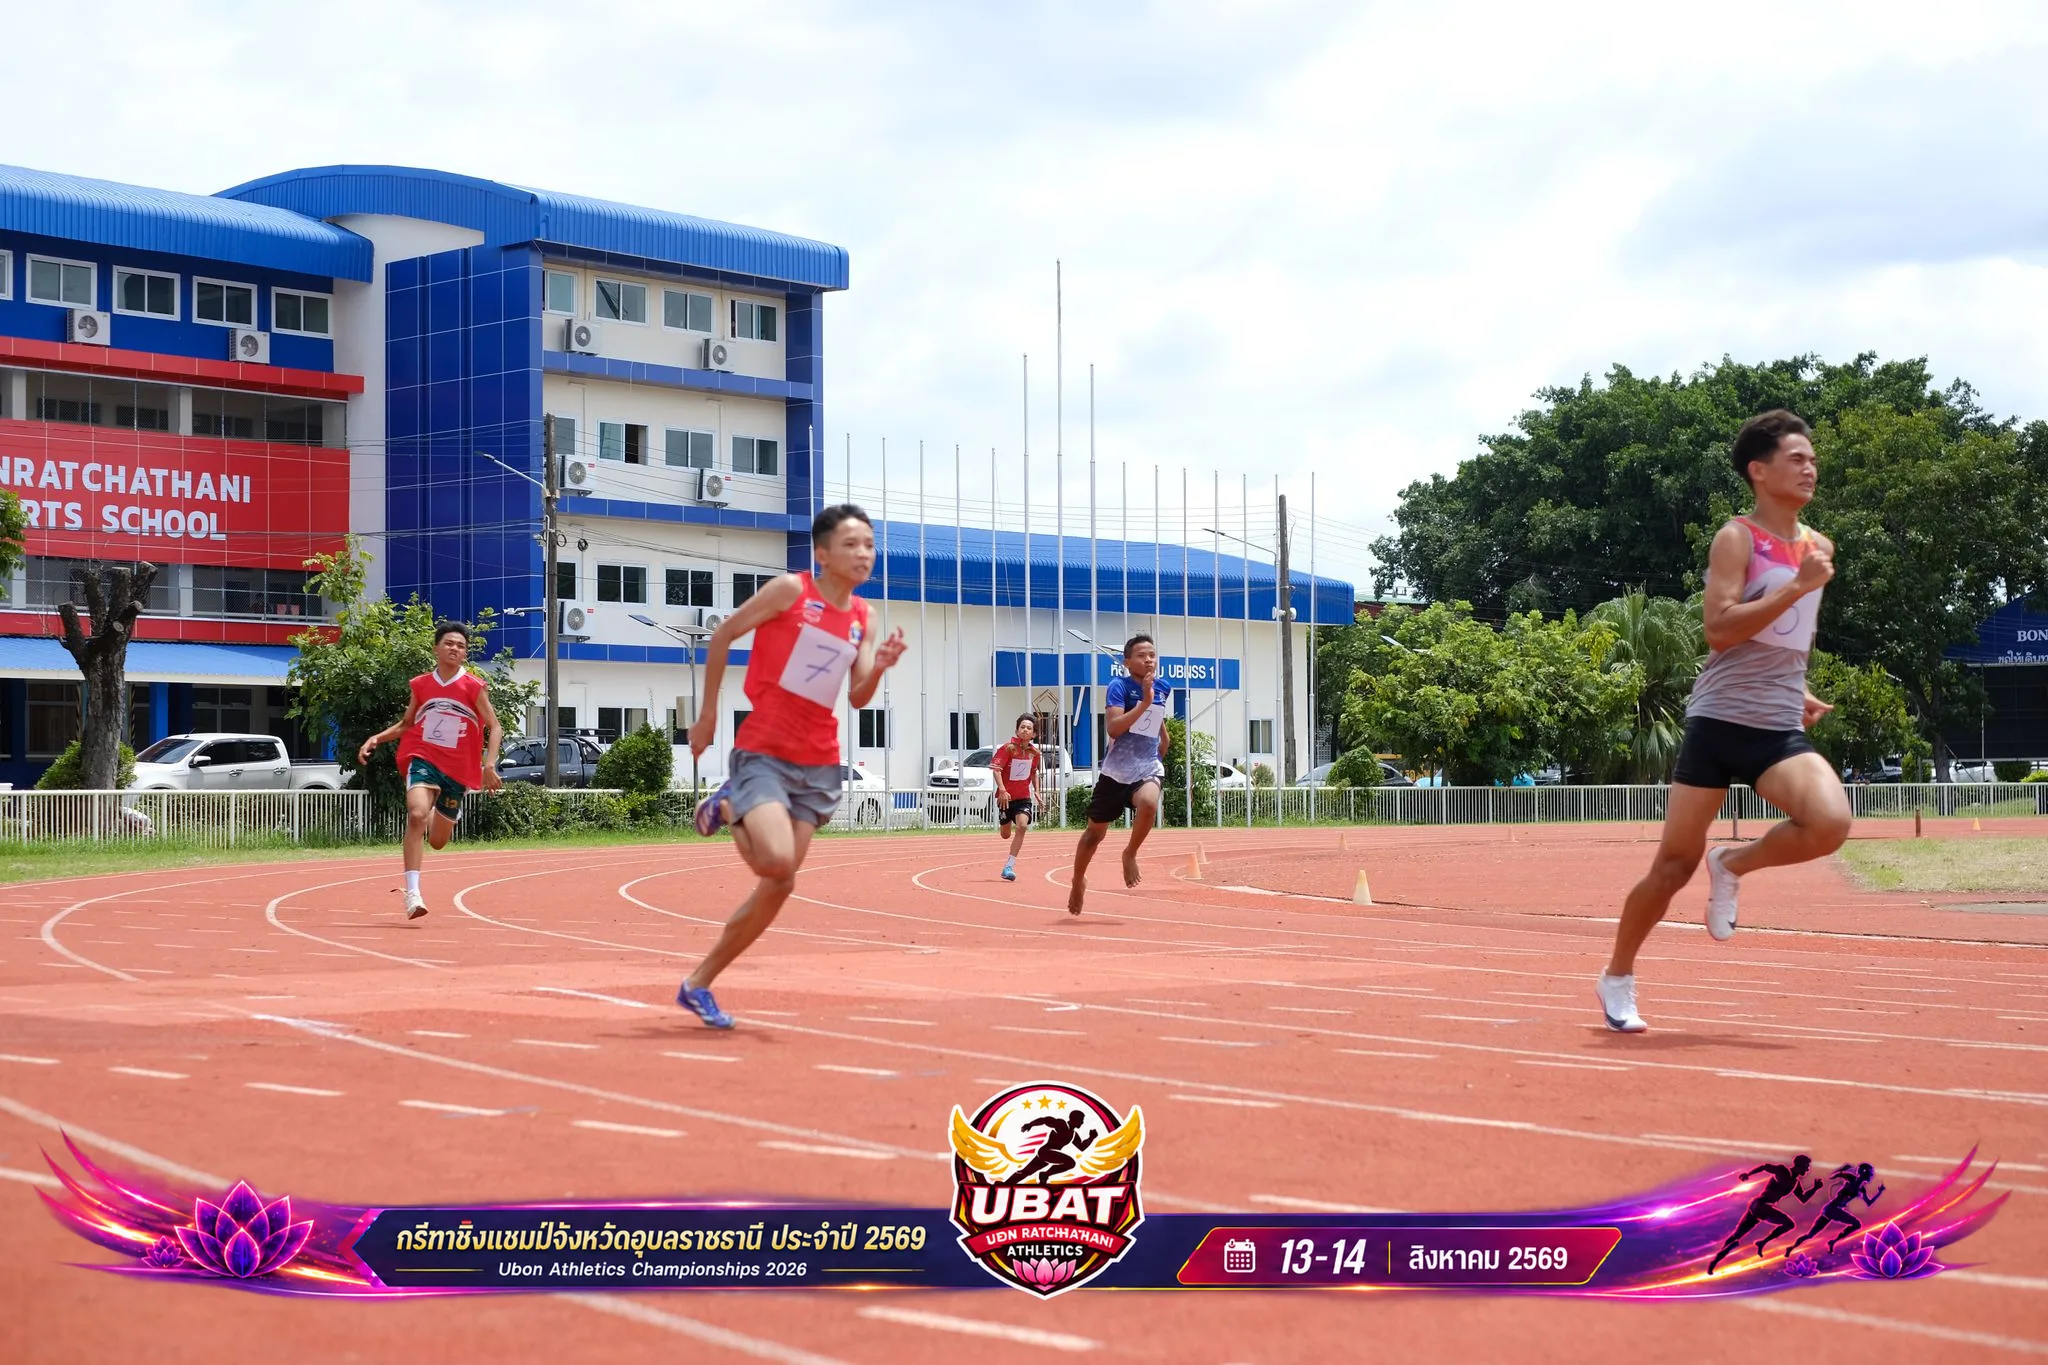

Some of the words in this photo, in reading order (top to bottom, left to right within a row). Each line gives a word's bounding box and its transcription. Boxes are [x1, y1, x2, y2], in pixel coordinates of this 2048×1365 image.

[20, 499, 83, 531] RTS
[102, 503, 227, 541] SCHOOL
[2017, 629, 2048, 642] BON
[805, 643, 841, 683] 7
[1209, 665, 1215, 680] 1
[431, 718, 443, 739] 6
[1138, 709, 1153, 732] 3
[1015, 762, 1026, 777] 2
